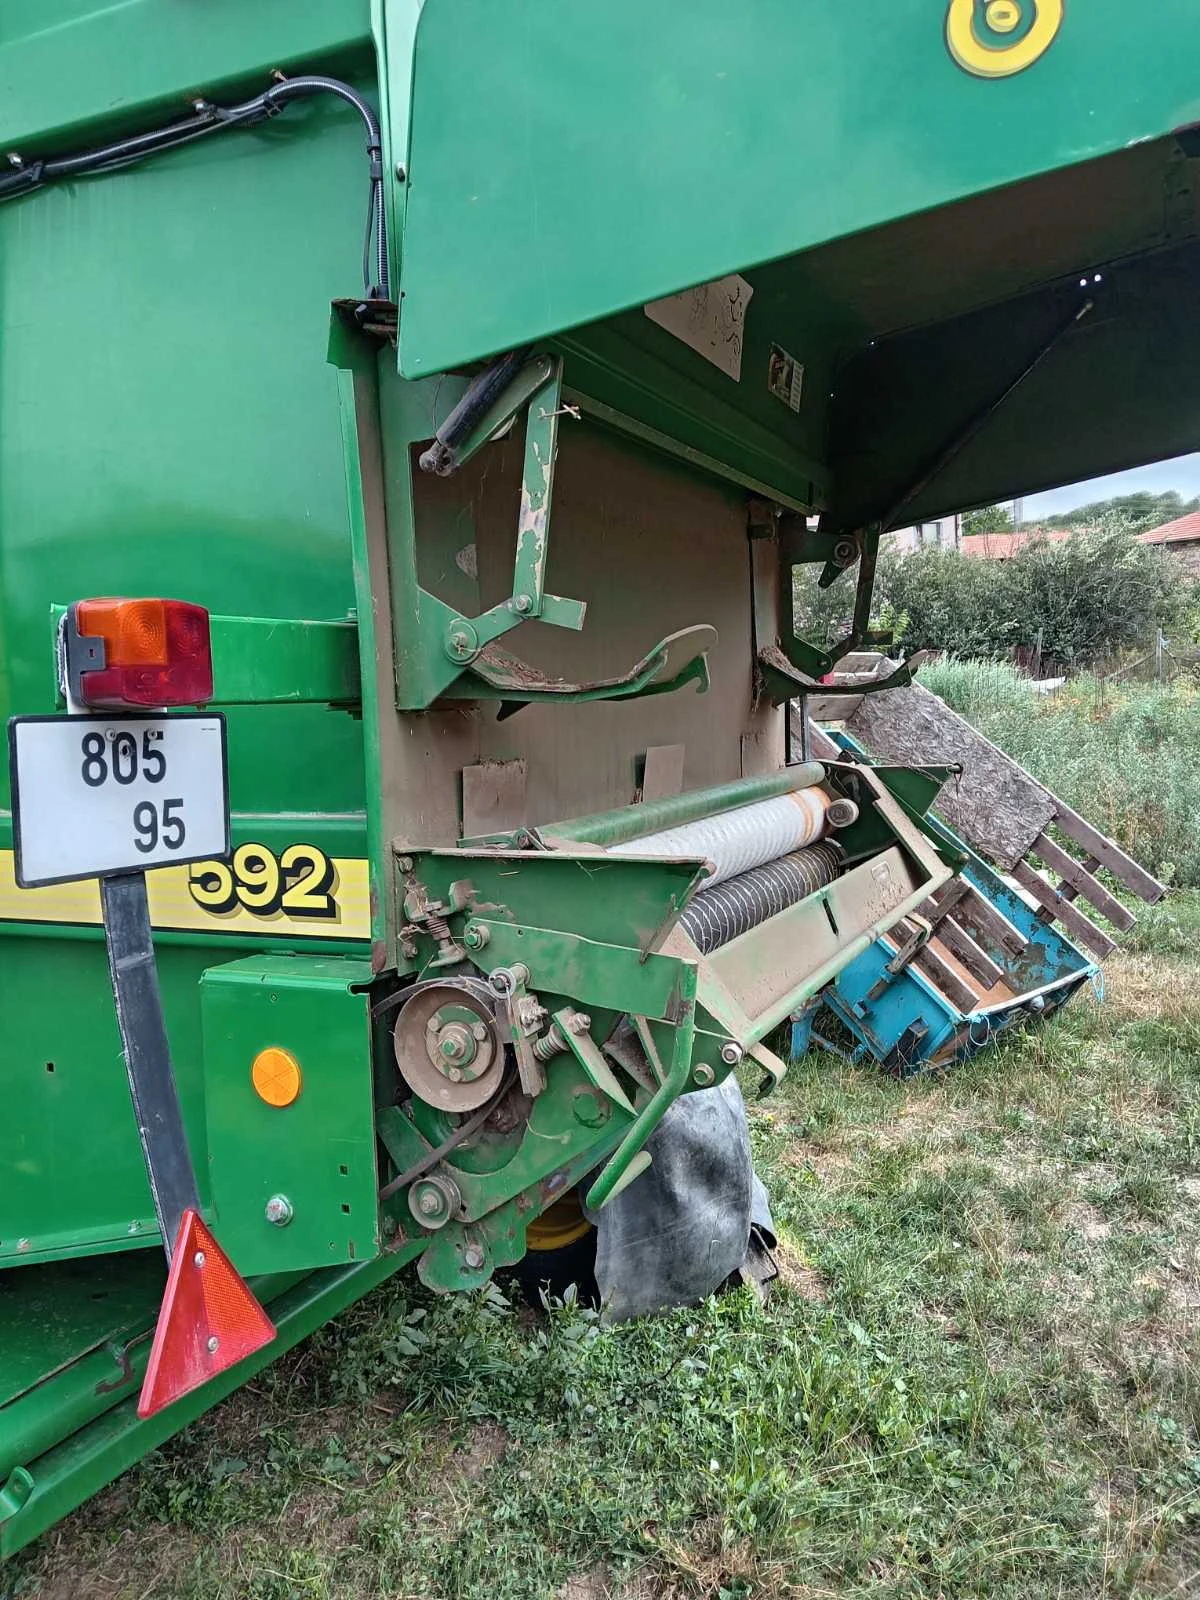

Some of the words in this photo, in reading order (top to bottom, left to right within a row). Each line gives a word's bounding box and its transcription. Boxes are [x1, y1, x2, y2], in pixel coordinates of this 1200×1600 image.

[81, 730, 166, 787] 805
[133, 798, 186, 853] 95
[188, 843, 339, 921] 592
